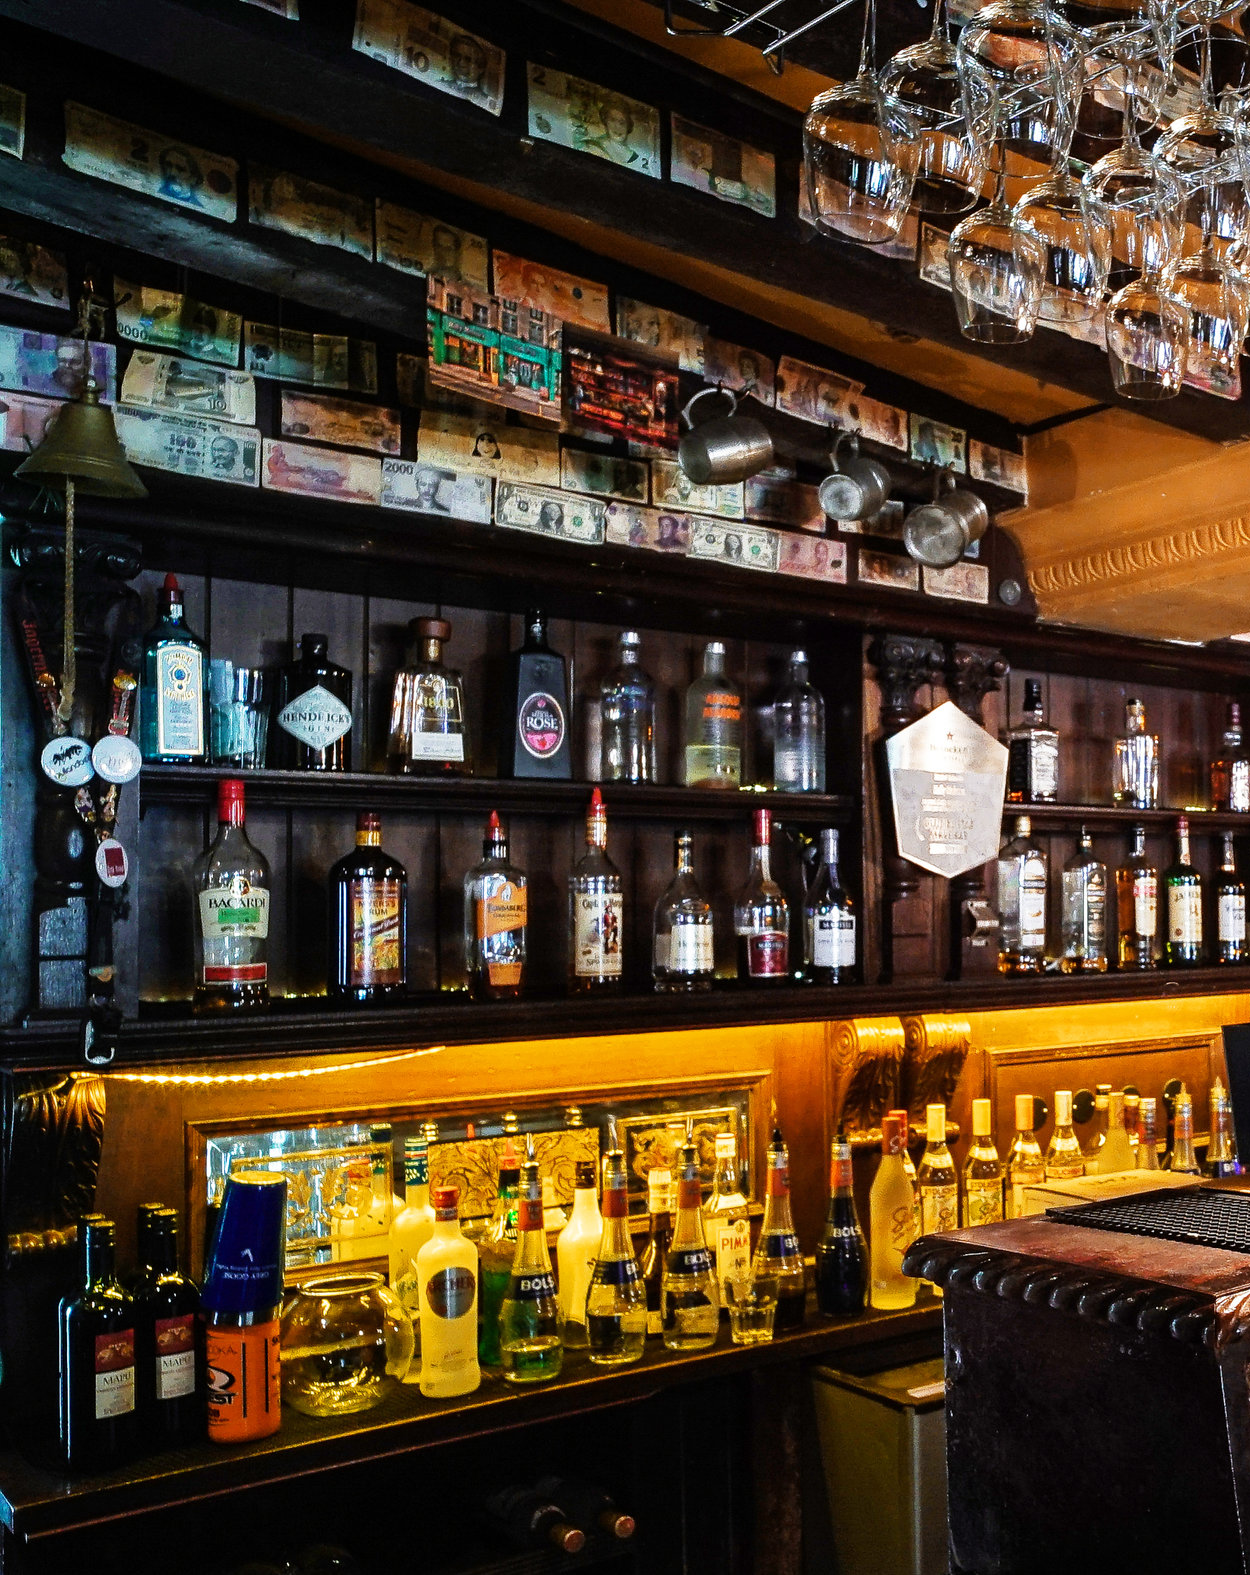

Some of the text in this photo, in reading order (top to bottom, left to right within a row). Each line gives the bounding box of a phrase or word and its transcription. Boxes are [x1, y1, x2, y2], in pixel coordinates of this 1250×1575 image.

[405, 46, 429, 72] 10
[532, 66, 546, 86] 2
[641, 157, 648, 169] 2
[384, 461, 414, 476] 2000
[527, 716, 559, 730] ROSE
[208, 898, 266, 909] BACARDI
[832, 1226, 862, 1238] BOLS
[520, 1276, 554, 1291] BOLS
